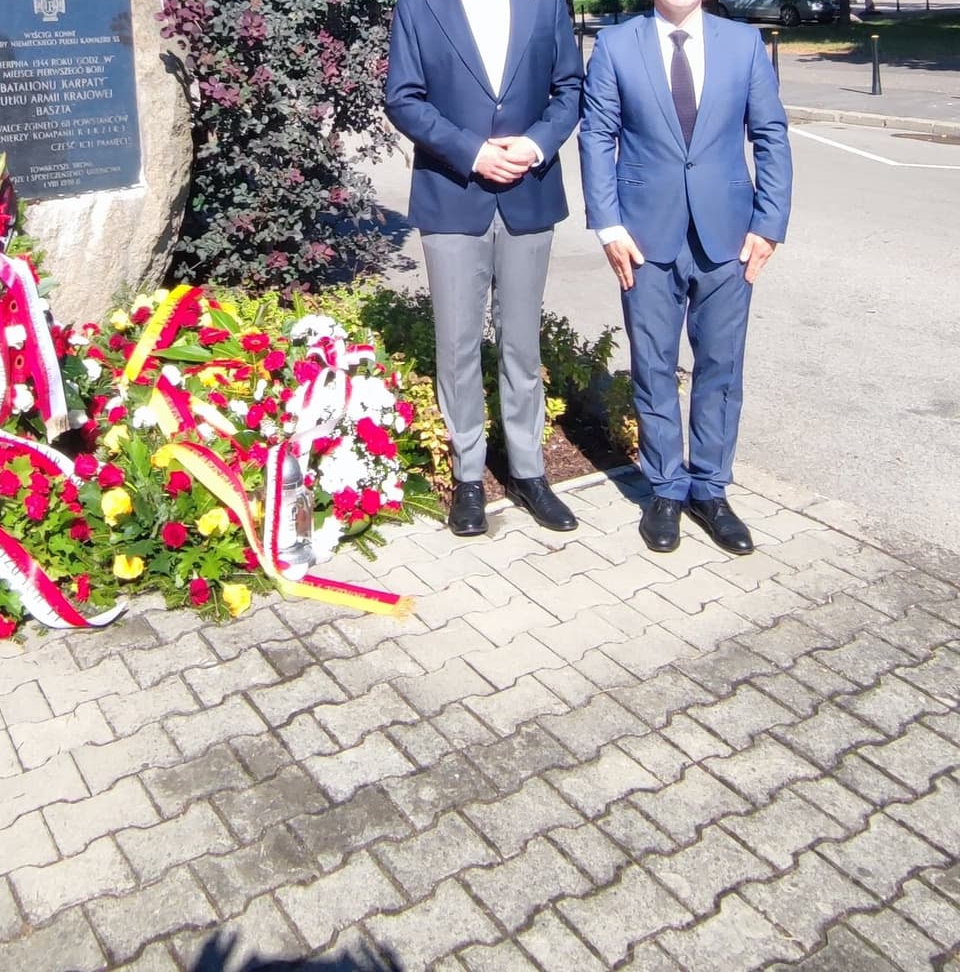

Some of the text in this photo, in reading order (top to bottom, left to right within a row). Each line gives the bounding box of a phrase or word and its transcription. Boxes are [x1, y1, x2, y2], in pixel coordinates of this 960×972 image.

[51, 57, 73, 67] ROKU
[3, 69, 34, 78] MIEJSCE
[37, 67, 82, 77] PIERWSZEGO
[0, 81, 56, 93] BATALIONU
[31, 93, 60, 104] ARMII
[63, 89, 113, 101] KRAJOWEJ
